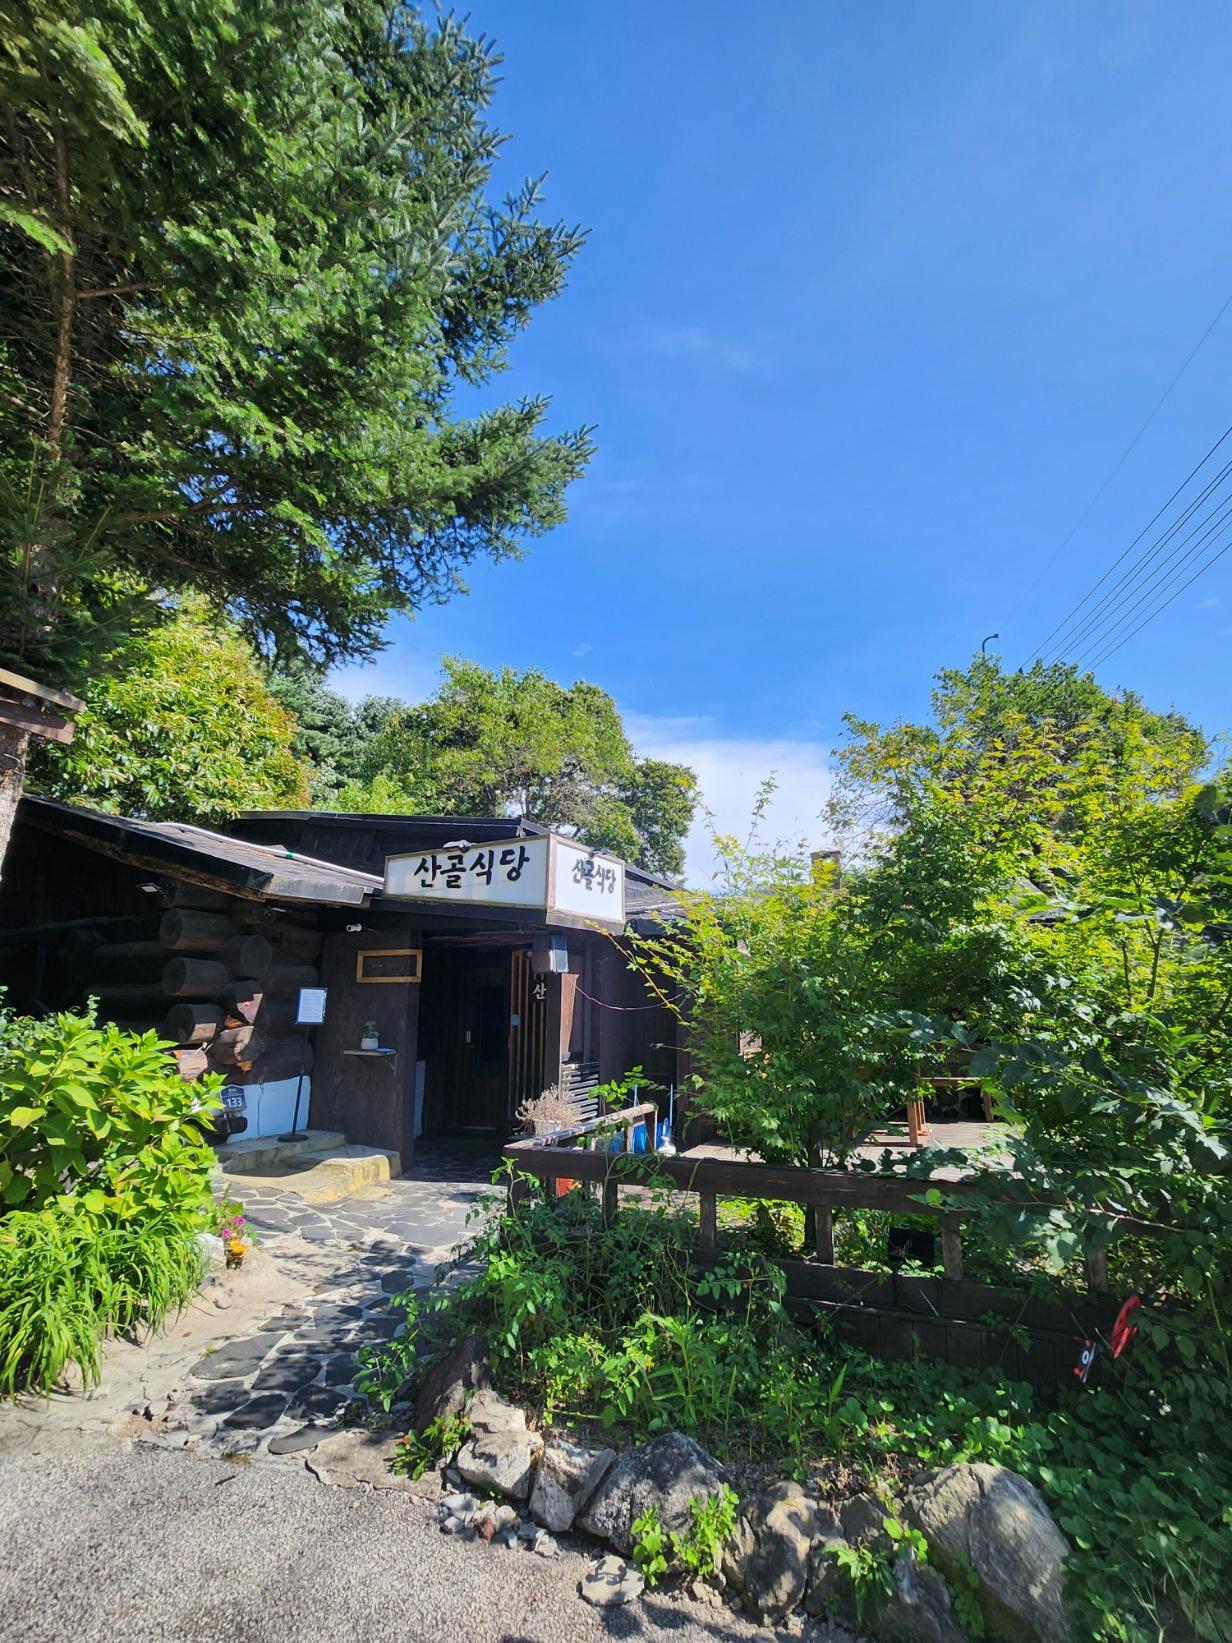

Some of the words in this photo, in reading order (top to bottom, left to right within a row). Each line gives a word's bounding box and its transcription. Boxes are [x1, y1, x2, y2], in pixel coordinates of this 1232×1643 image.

[414, 846, 529, 889] 산골식당
[571, 858, 617, 894] 산골식당
[532, 983, 547, 1000] 산
[227, 1097, 242, 1108] 133
